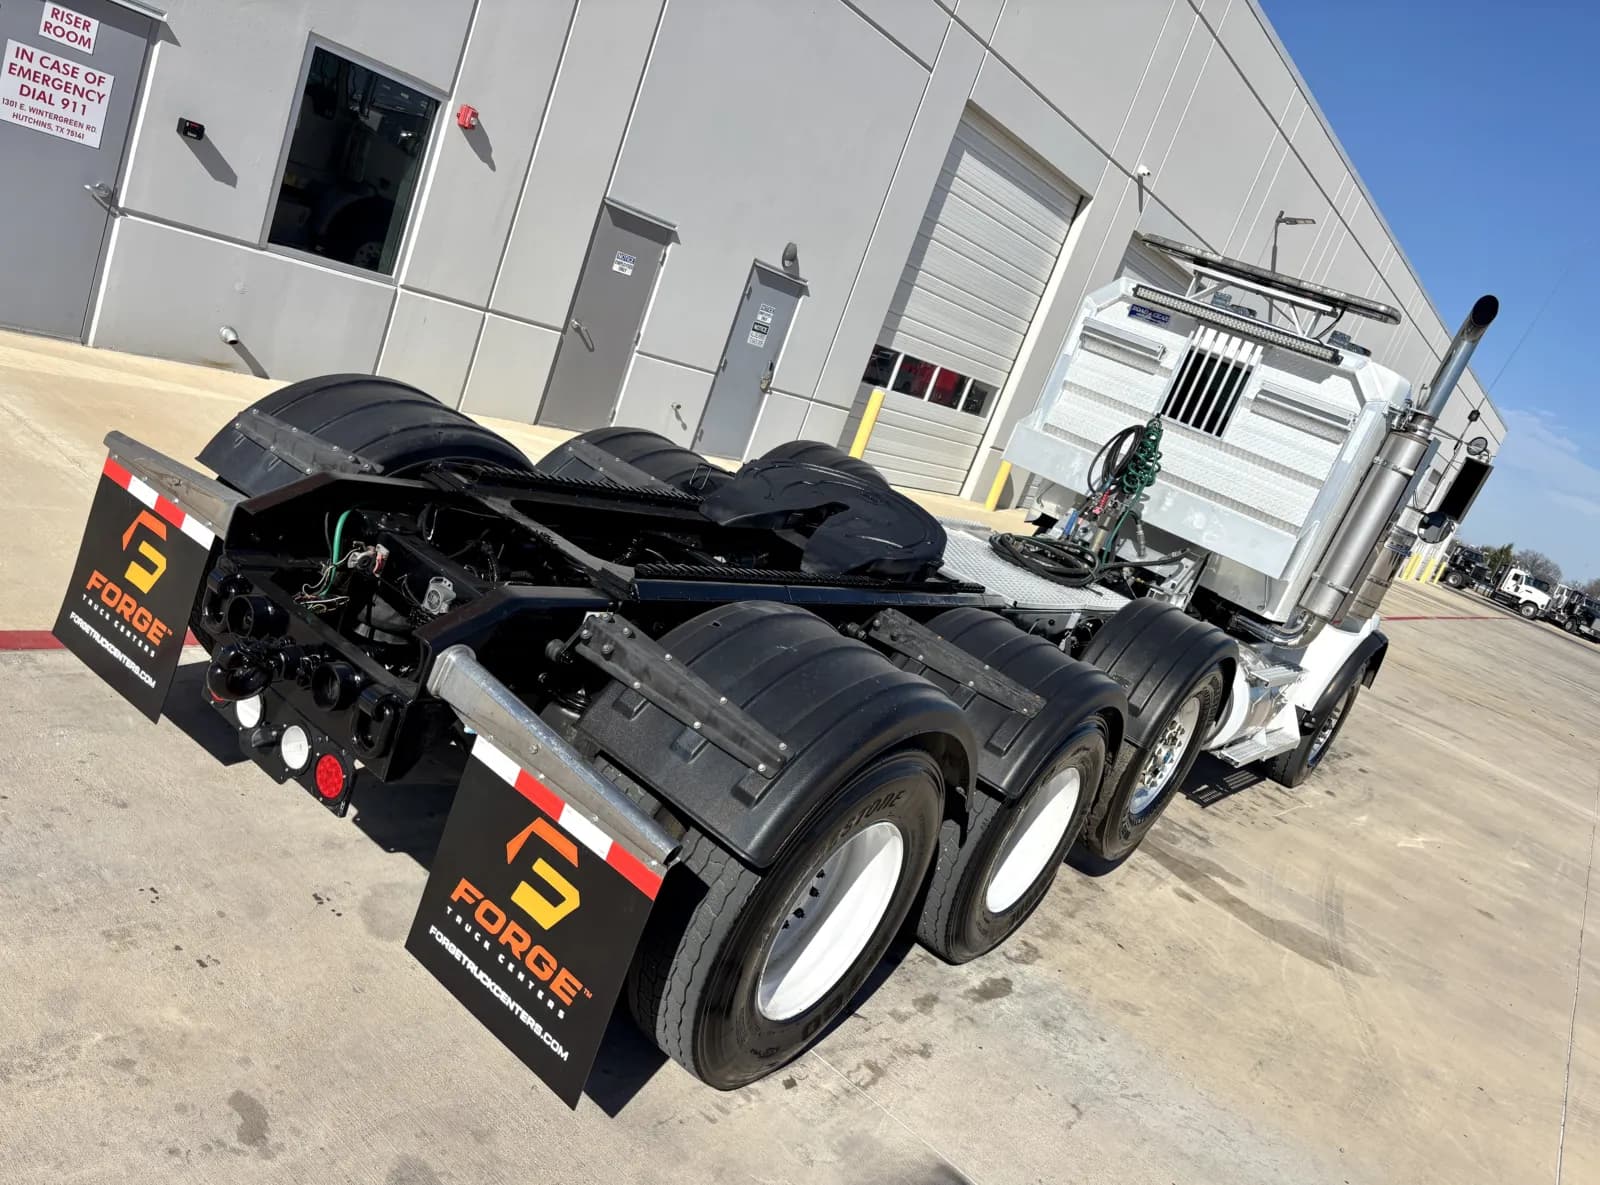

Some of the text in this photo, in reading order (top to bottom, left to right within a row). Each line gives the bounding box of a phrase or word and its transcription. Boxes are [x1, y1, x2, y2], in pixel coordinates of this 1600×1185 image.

[43, 21, 92, 49] ROOM
[51, 7, 91, 33] RISER
[8, 62, 106, 104] EMERGENCY
[15, 46, 106, 87] IN CASE OF
[2, 97, 18, 108] 1301
[29, 106, 84, 129] WINTERGREEN
[19, 84, 87, 116] DIAL 911
[55, 125, 64, 134] TX
[66, 128, 85, 140] 75141
[82, 594, 155, 657] TRUCK CENTERS
[69, 611, 157, 689] FORGETRUCKCENTERS.COM
[446, 906, 565, 1020] TRUCK CENTERS
[429, 925, 569, 1061] FORGETRUCKCENTERS.COM
